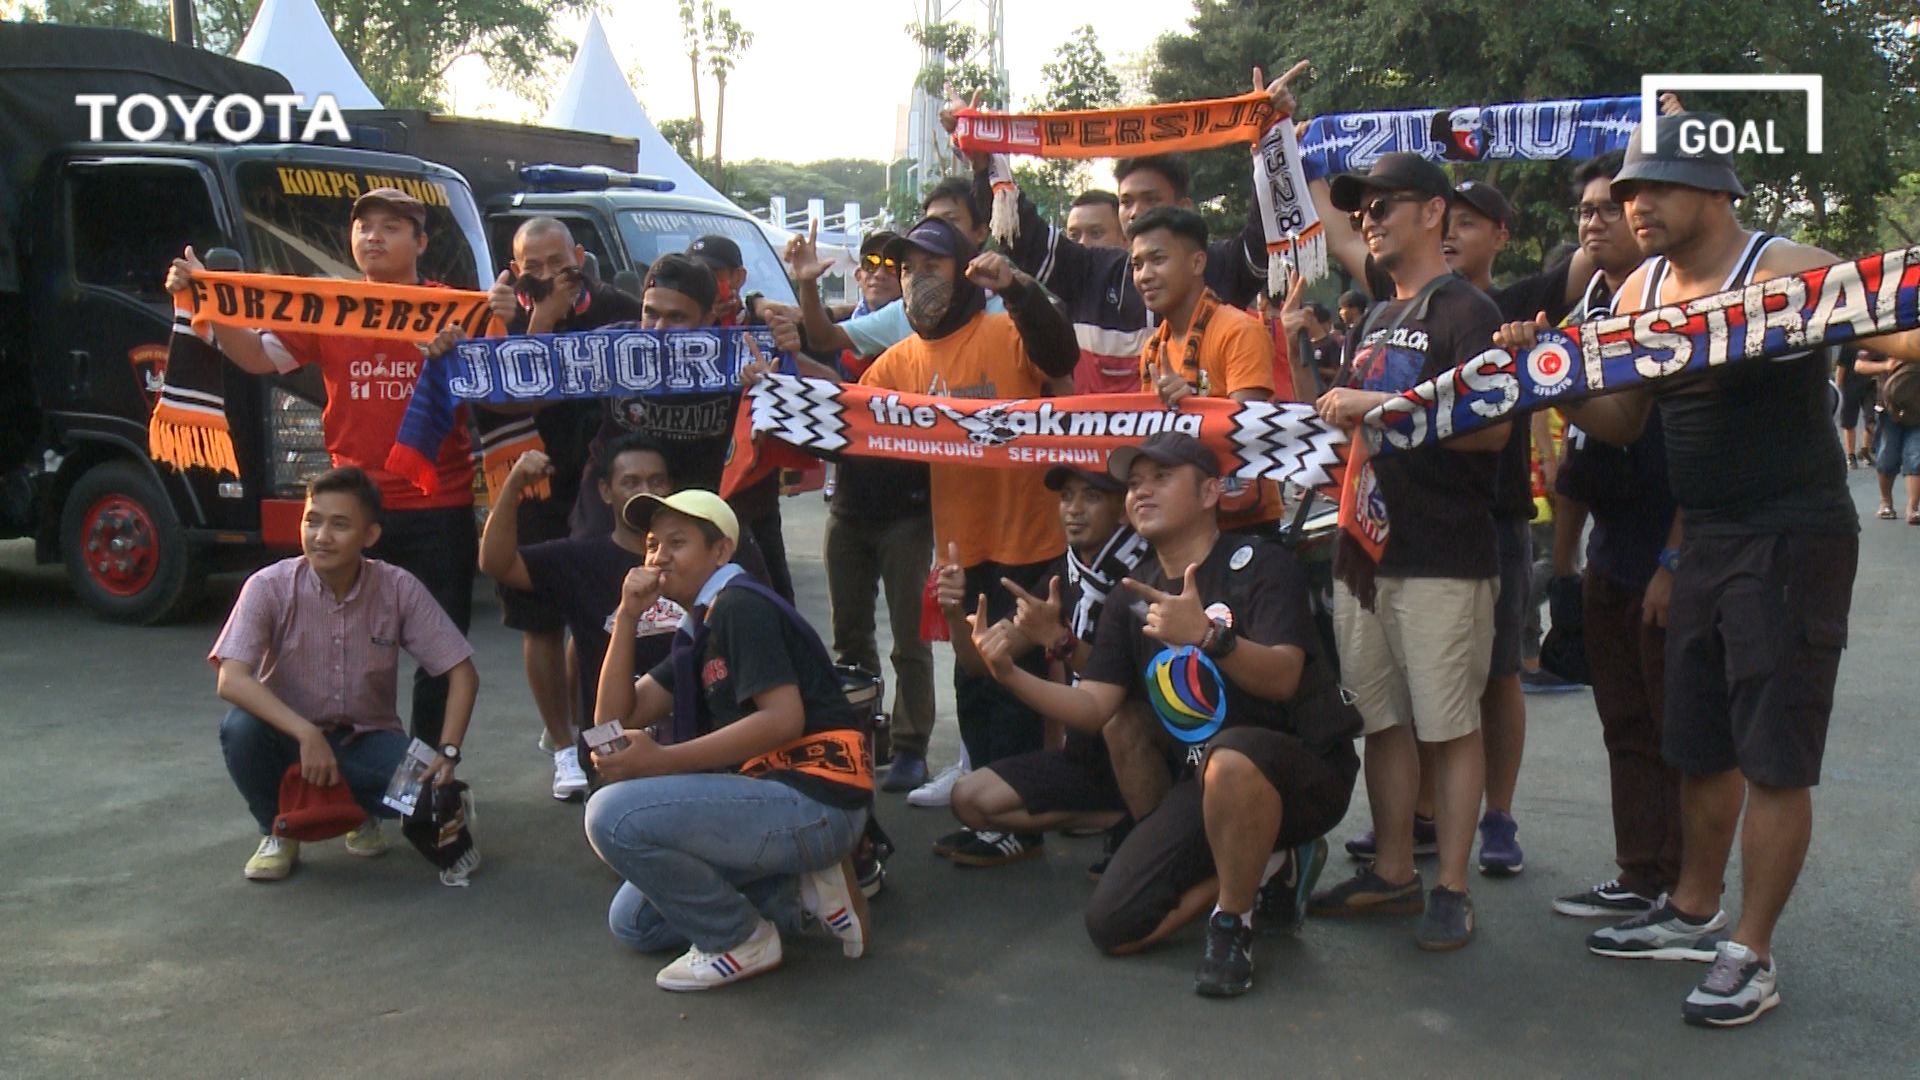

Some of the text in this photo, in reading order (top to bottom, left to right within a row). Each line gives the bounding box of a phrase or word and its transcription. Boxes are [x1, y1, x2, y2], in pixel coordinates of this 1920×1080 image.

[1043, 102, 1273, 147] PERSIJA
[277, 167, 361, 198] KORPS
[1261, 127, 1305, 238] 1928
[191, 282, 325, 324] FORZA
[1633, 246, 1920, 379] STRAI
[375, 381, 415, 400] TOA
[867, 395, 937, 428] the
[867, 435, 984, 459] MENDUKUNG
[1008, 446, 1101, 465] SEPENUH
